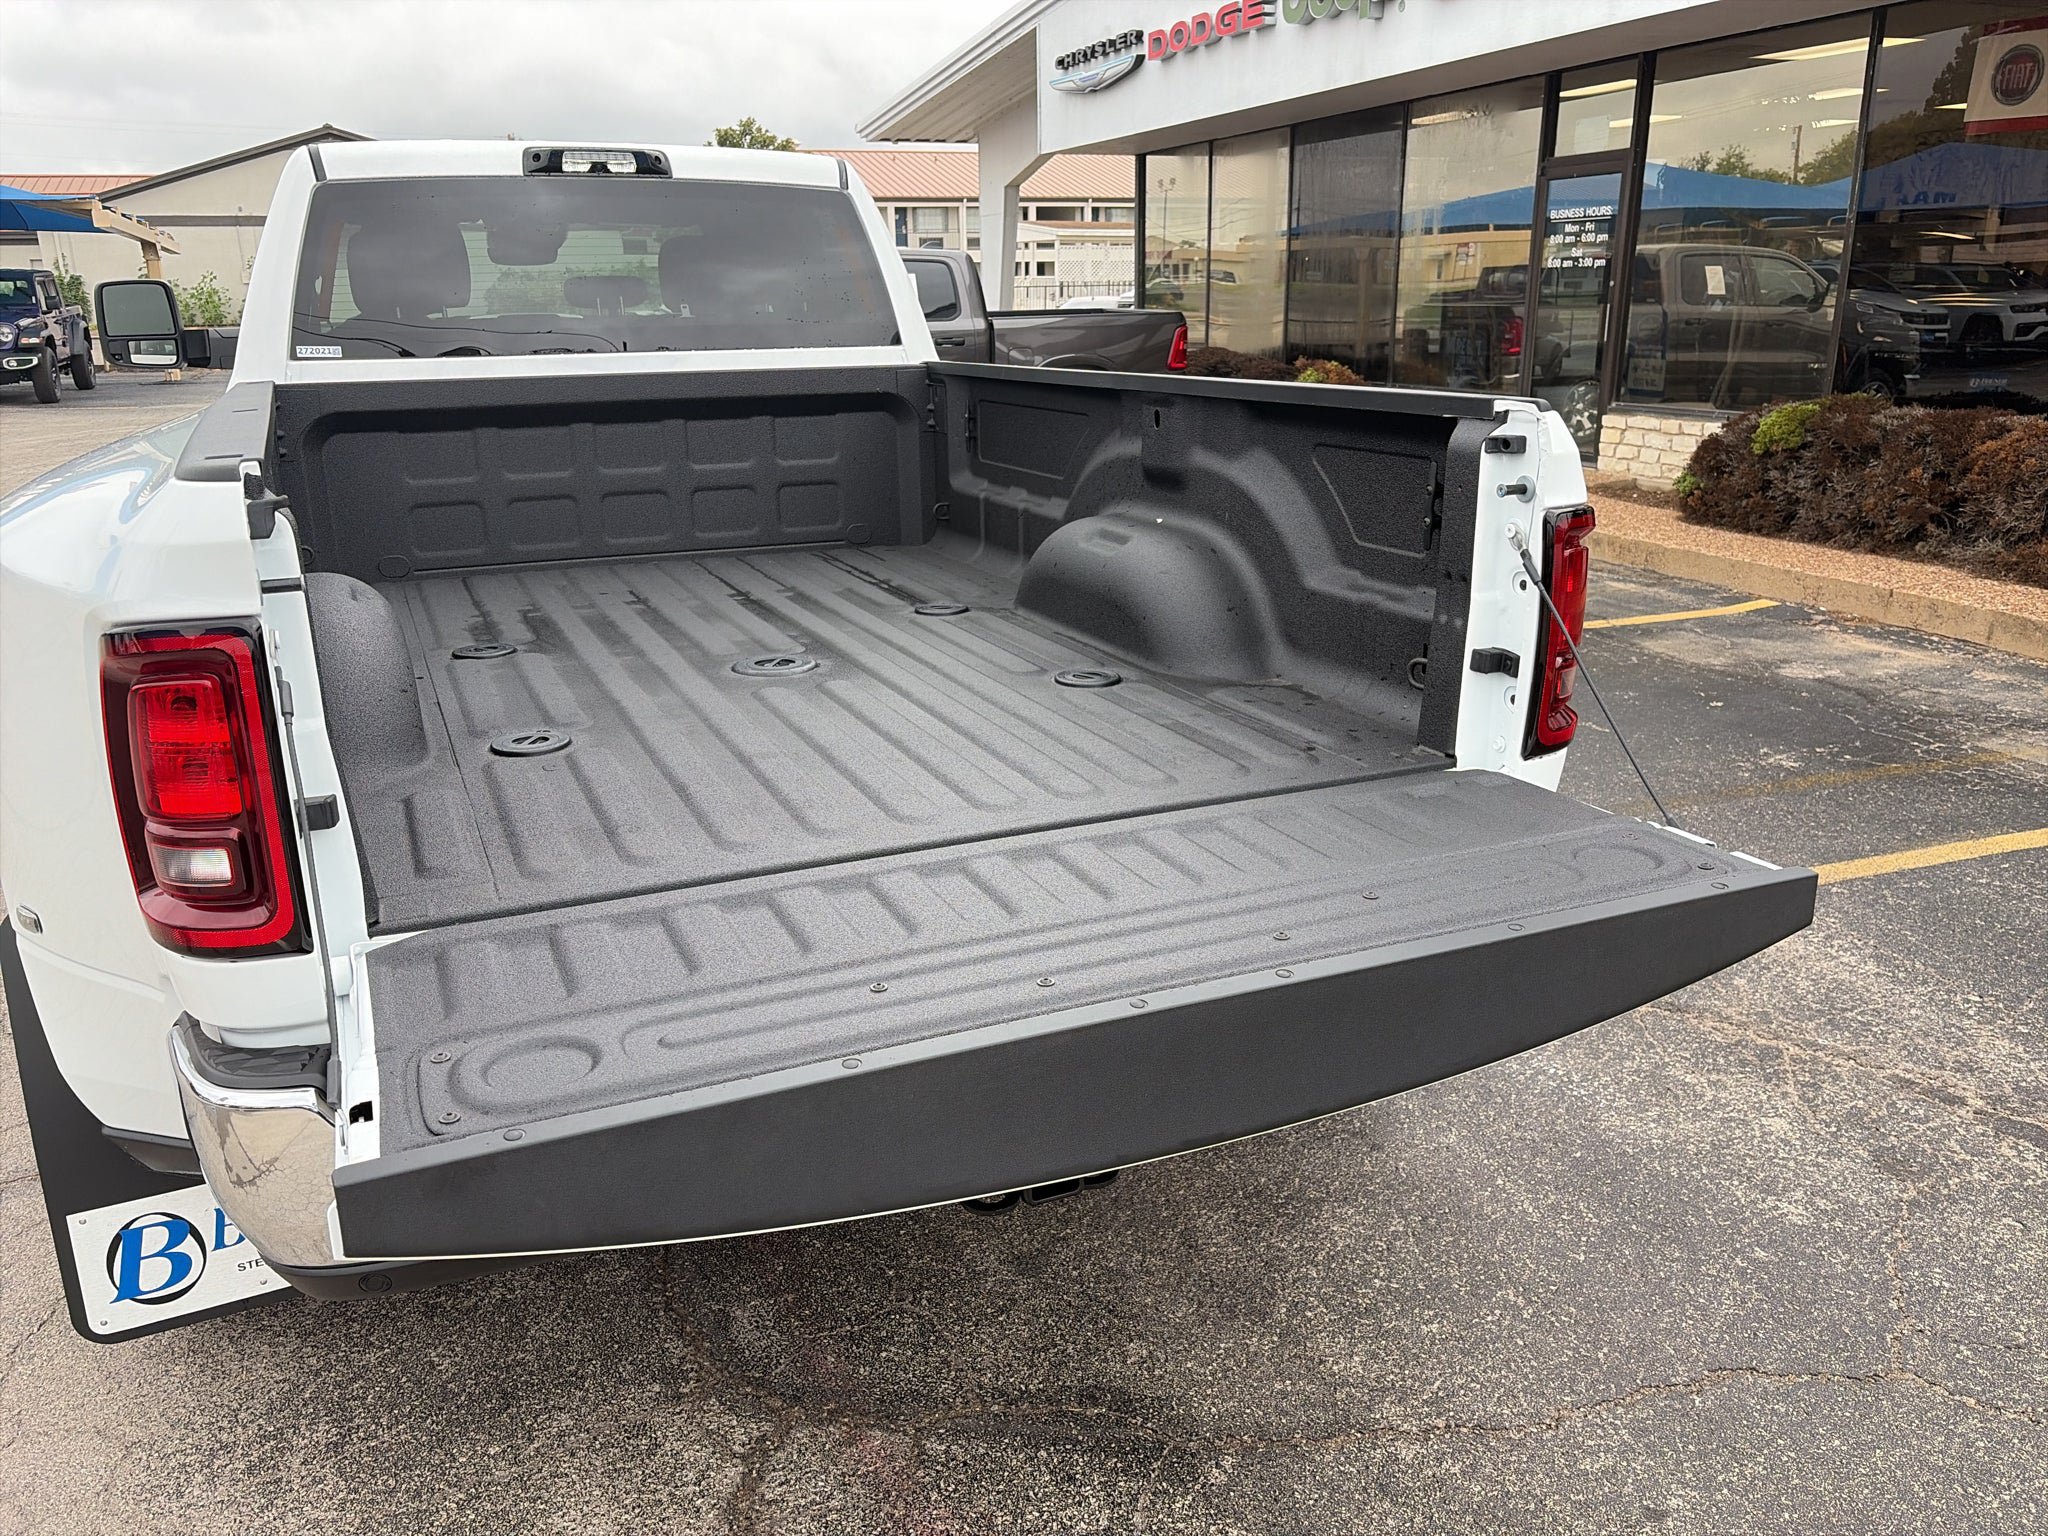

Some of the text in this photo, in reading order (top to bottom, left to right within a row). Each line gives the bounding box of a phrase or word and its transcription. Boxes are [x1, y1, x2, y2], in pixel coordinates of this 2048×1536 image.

[1148, 0, 1267, 61] DODGE
[1055, 29, 1141, 70] CHRYSLER
[2003, 63, 2033, 90] FIAT
[1550, 206, 1613, 219] BUSINESS HOURS:
[1564, 223, 1579, 233] Mon
[1585, 222, 1595, 232] Fri
[1564, 235, 1575, 243] am
[1581, 233, 1596, 242] 6:00
[1596, 233, 1609, 243] pm
[1571, 247, 1583, 257] Sat
[1562, 259, 1573, 267] am
[1578, 257, 1593, 267] 3:00
[1593, 258, 1606, 269] pm
[297, 347, 332, 355] 272021
[109, 1218, 193, 1305] B
